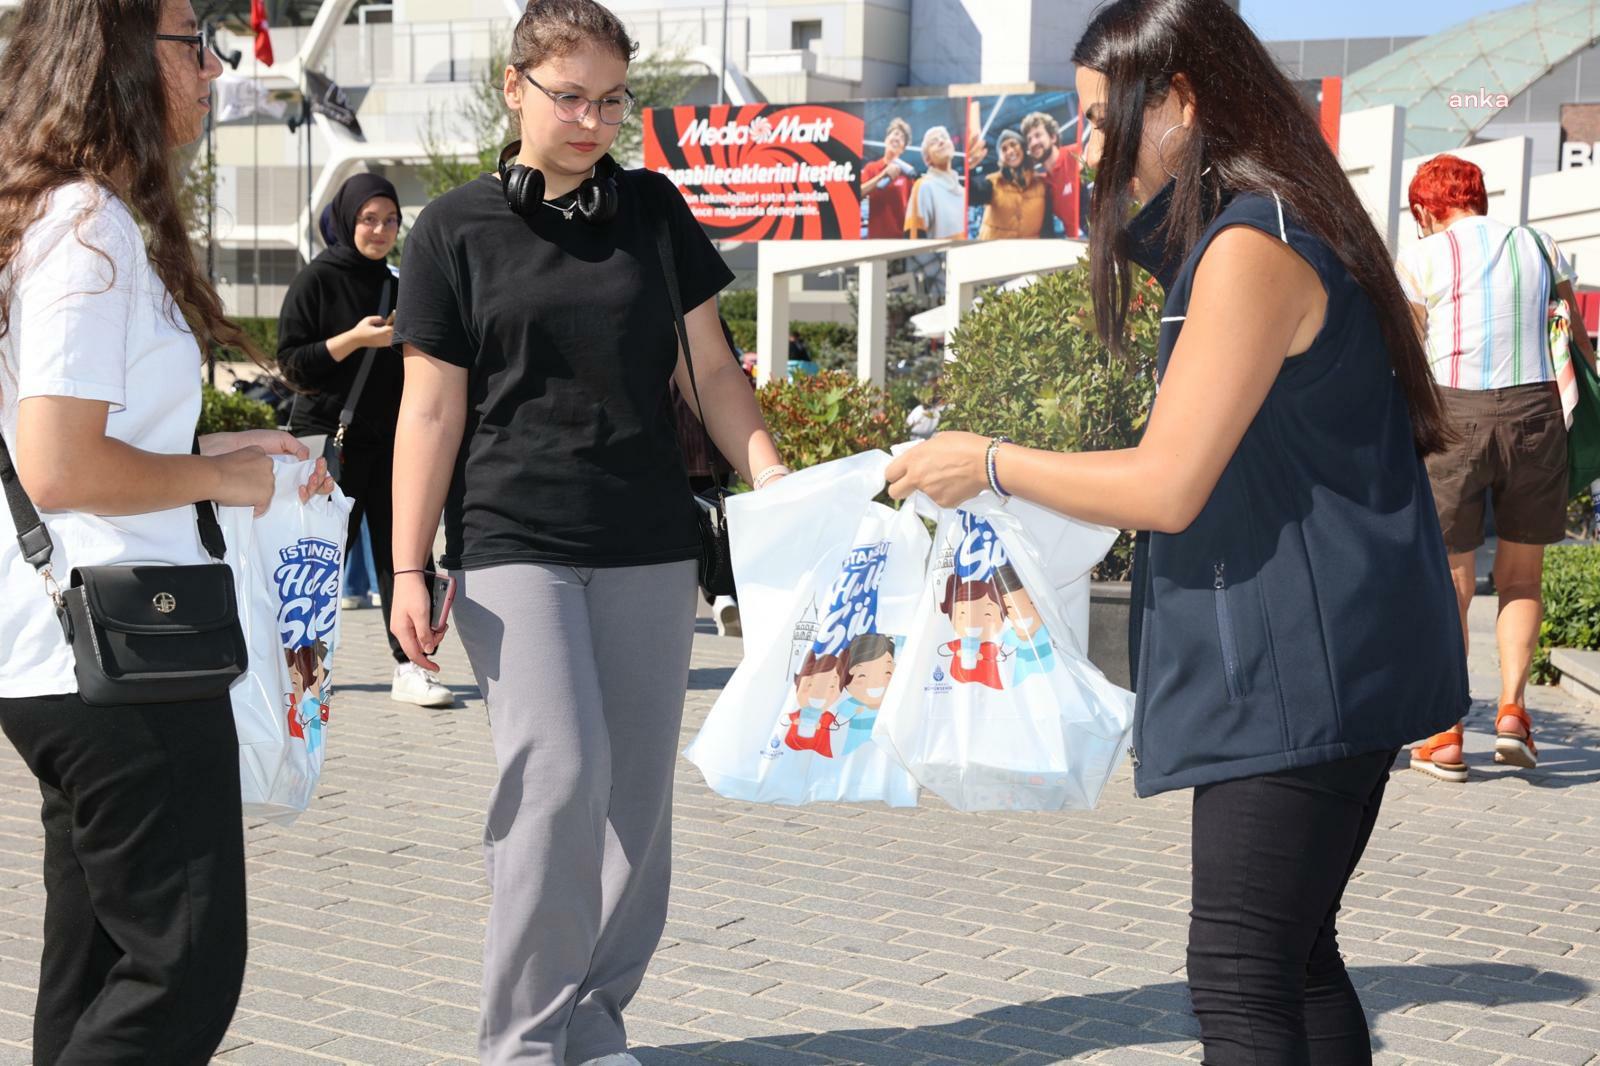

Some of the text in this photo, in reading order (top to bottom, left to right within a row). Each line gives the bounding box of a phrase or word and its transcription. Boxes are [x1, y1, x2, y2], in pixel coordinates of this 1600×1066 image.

[799, 160, 856, 187] keşfet.
[787, 190, 829, 202] almadan
[766, 204, 820, 218] deneyimle.
